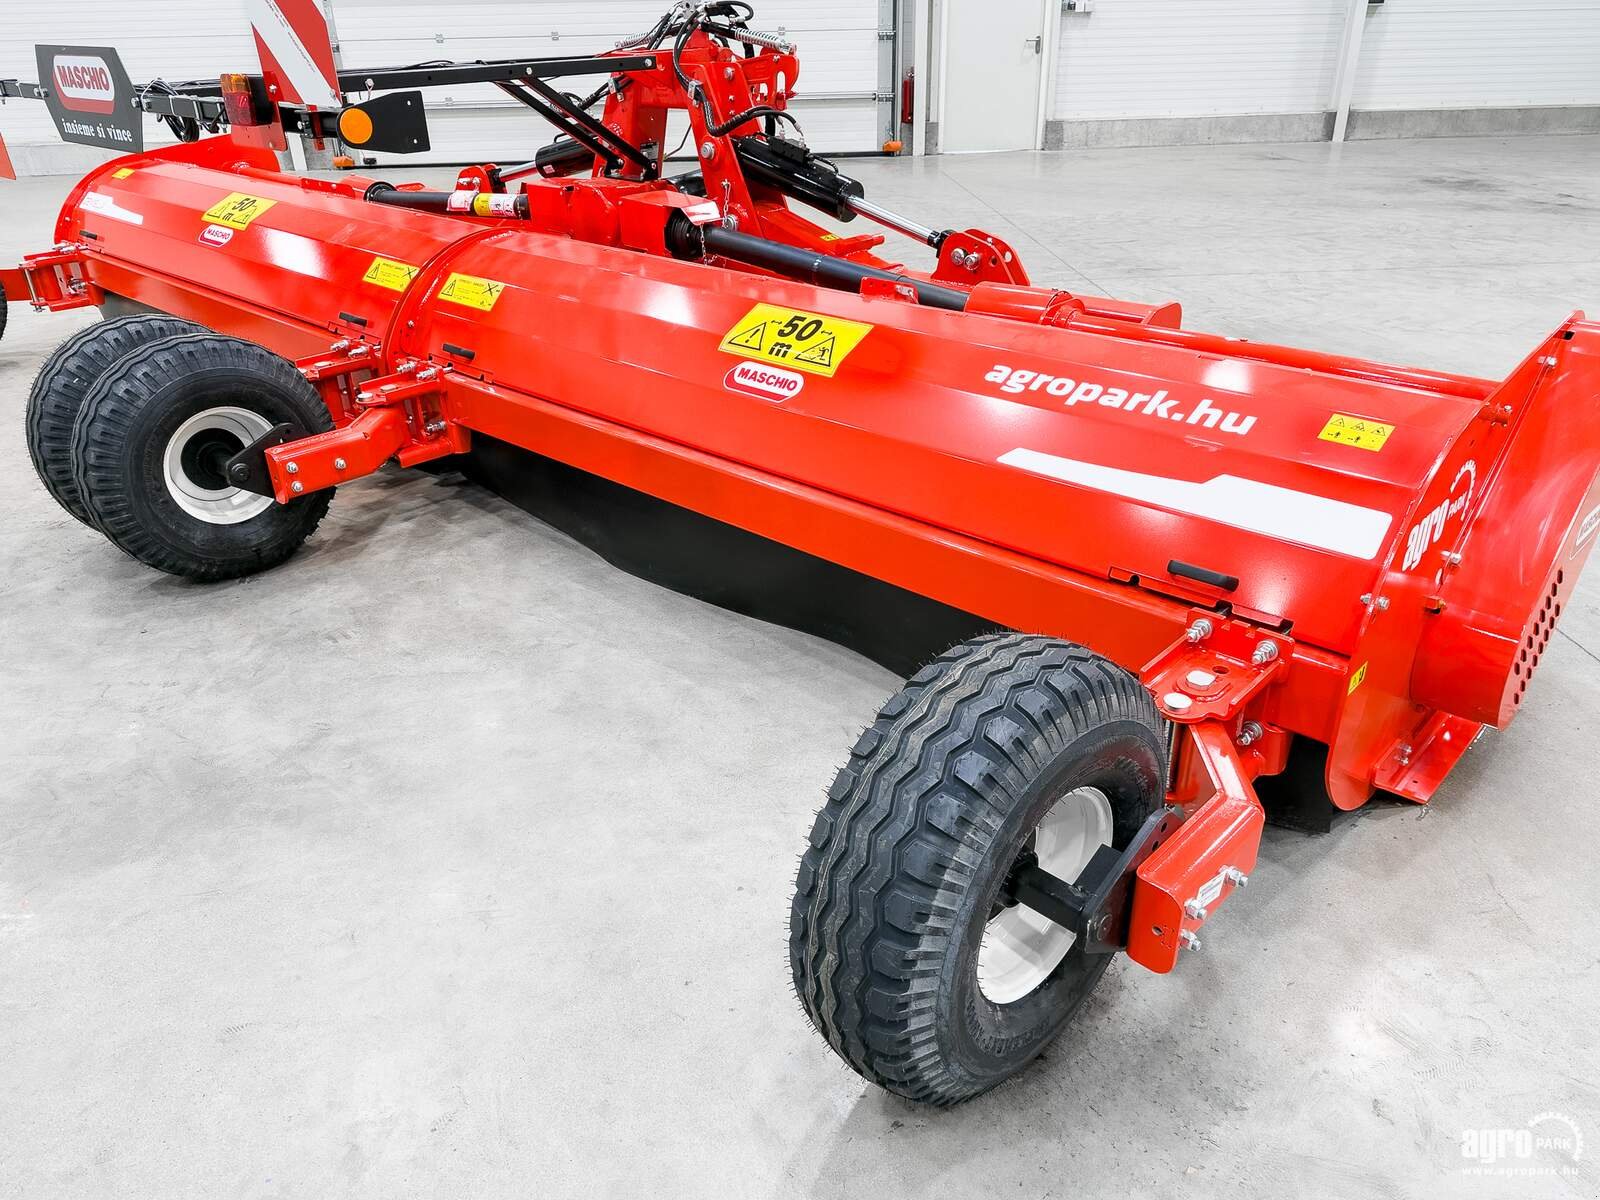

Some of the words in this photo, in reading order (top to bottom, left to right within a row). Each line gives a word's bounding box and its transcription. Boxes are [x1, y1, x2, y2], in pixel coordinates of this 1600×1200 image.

[57, 65, 110, 91] MASCHIO
[61, 118, 95, 137] insieme
[97, 123, 106, 138] si
[107, 124, 133, 142] vince
[232, 198, 257, 212] 50
[206, 227, 231, 240] MASCHIO
[777, 315, 823, 341] 50
[737, 367, 798, 391] MASCHIO
[984, 364, 1258, 435] agropark.hu
[1402, 499, 1450, 572] agro
[1447, 491, 1467, 520] PARK
